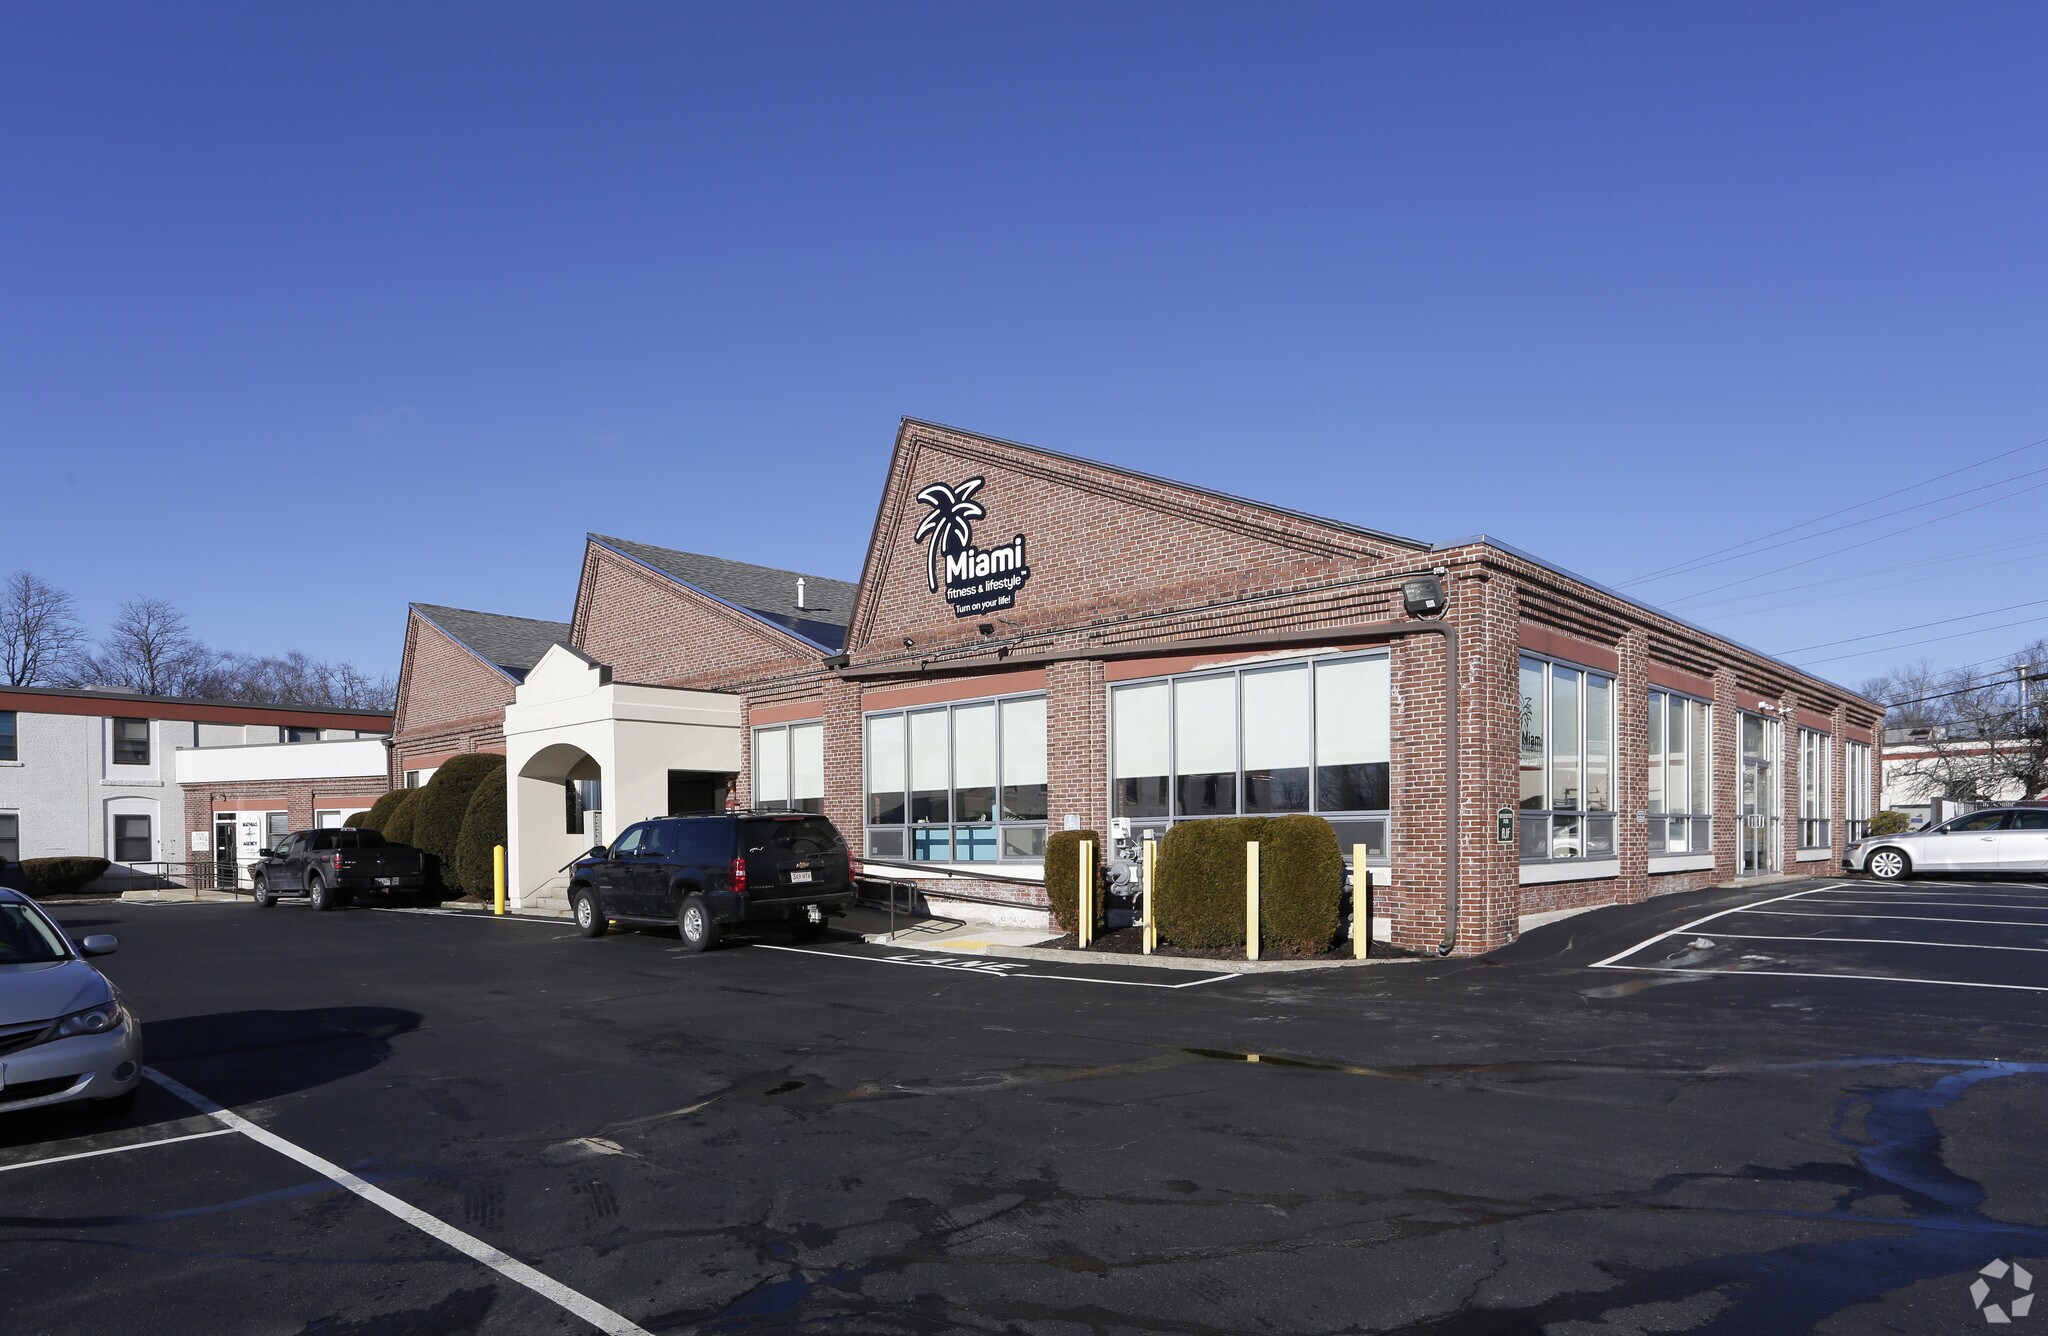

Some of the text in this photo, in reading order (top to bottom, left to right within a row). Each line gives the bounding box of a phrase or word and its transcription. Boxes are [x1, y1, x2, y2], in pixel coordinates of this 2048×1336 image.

[946, 537, 1022, 584] Miami
[947, 586, 977, 600] fitness
[978, 584, 984, 593] &
[985, 574, 1022, 592] lifestyle
[955, 595, 1011, 614] Turn on your life!
[1521, 730, 1544, 747] Miami
[883, 954, 1030, 972] LANE
